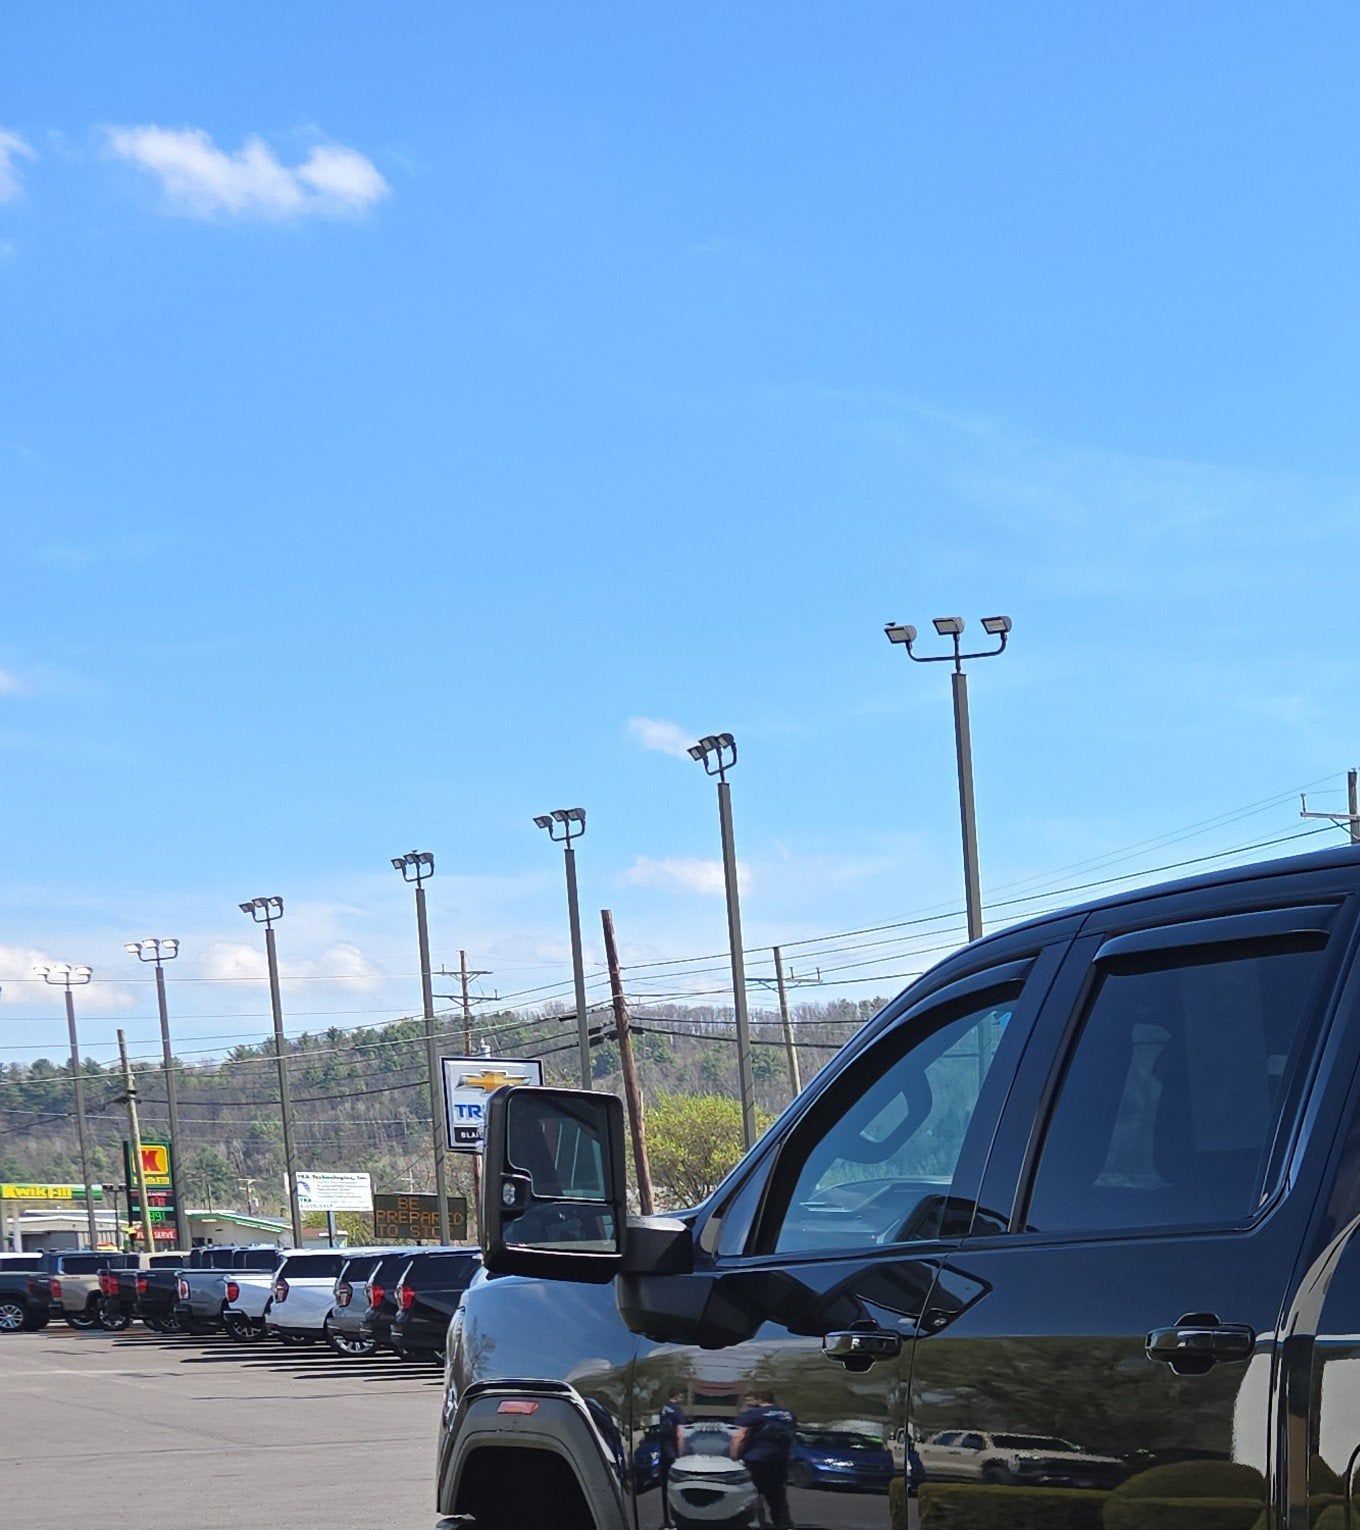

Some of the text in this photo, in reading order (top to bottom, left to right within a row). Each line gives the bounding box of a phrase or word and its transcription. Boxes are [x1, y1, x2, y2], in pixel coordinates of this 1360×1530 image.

[454, 1104, 486, 1118] TR
[397, 1198, 420, 1211] BE
[376, 1210, 464, 1226] PREPARD
[376, 1223, 399, 1237] TO
